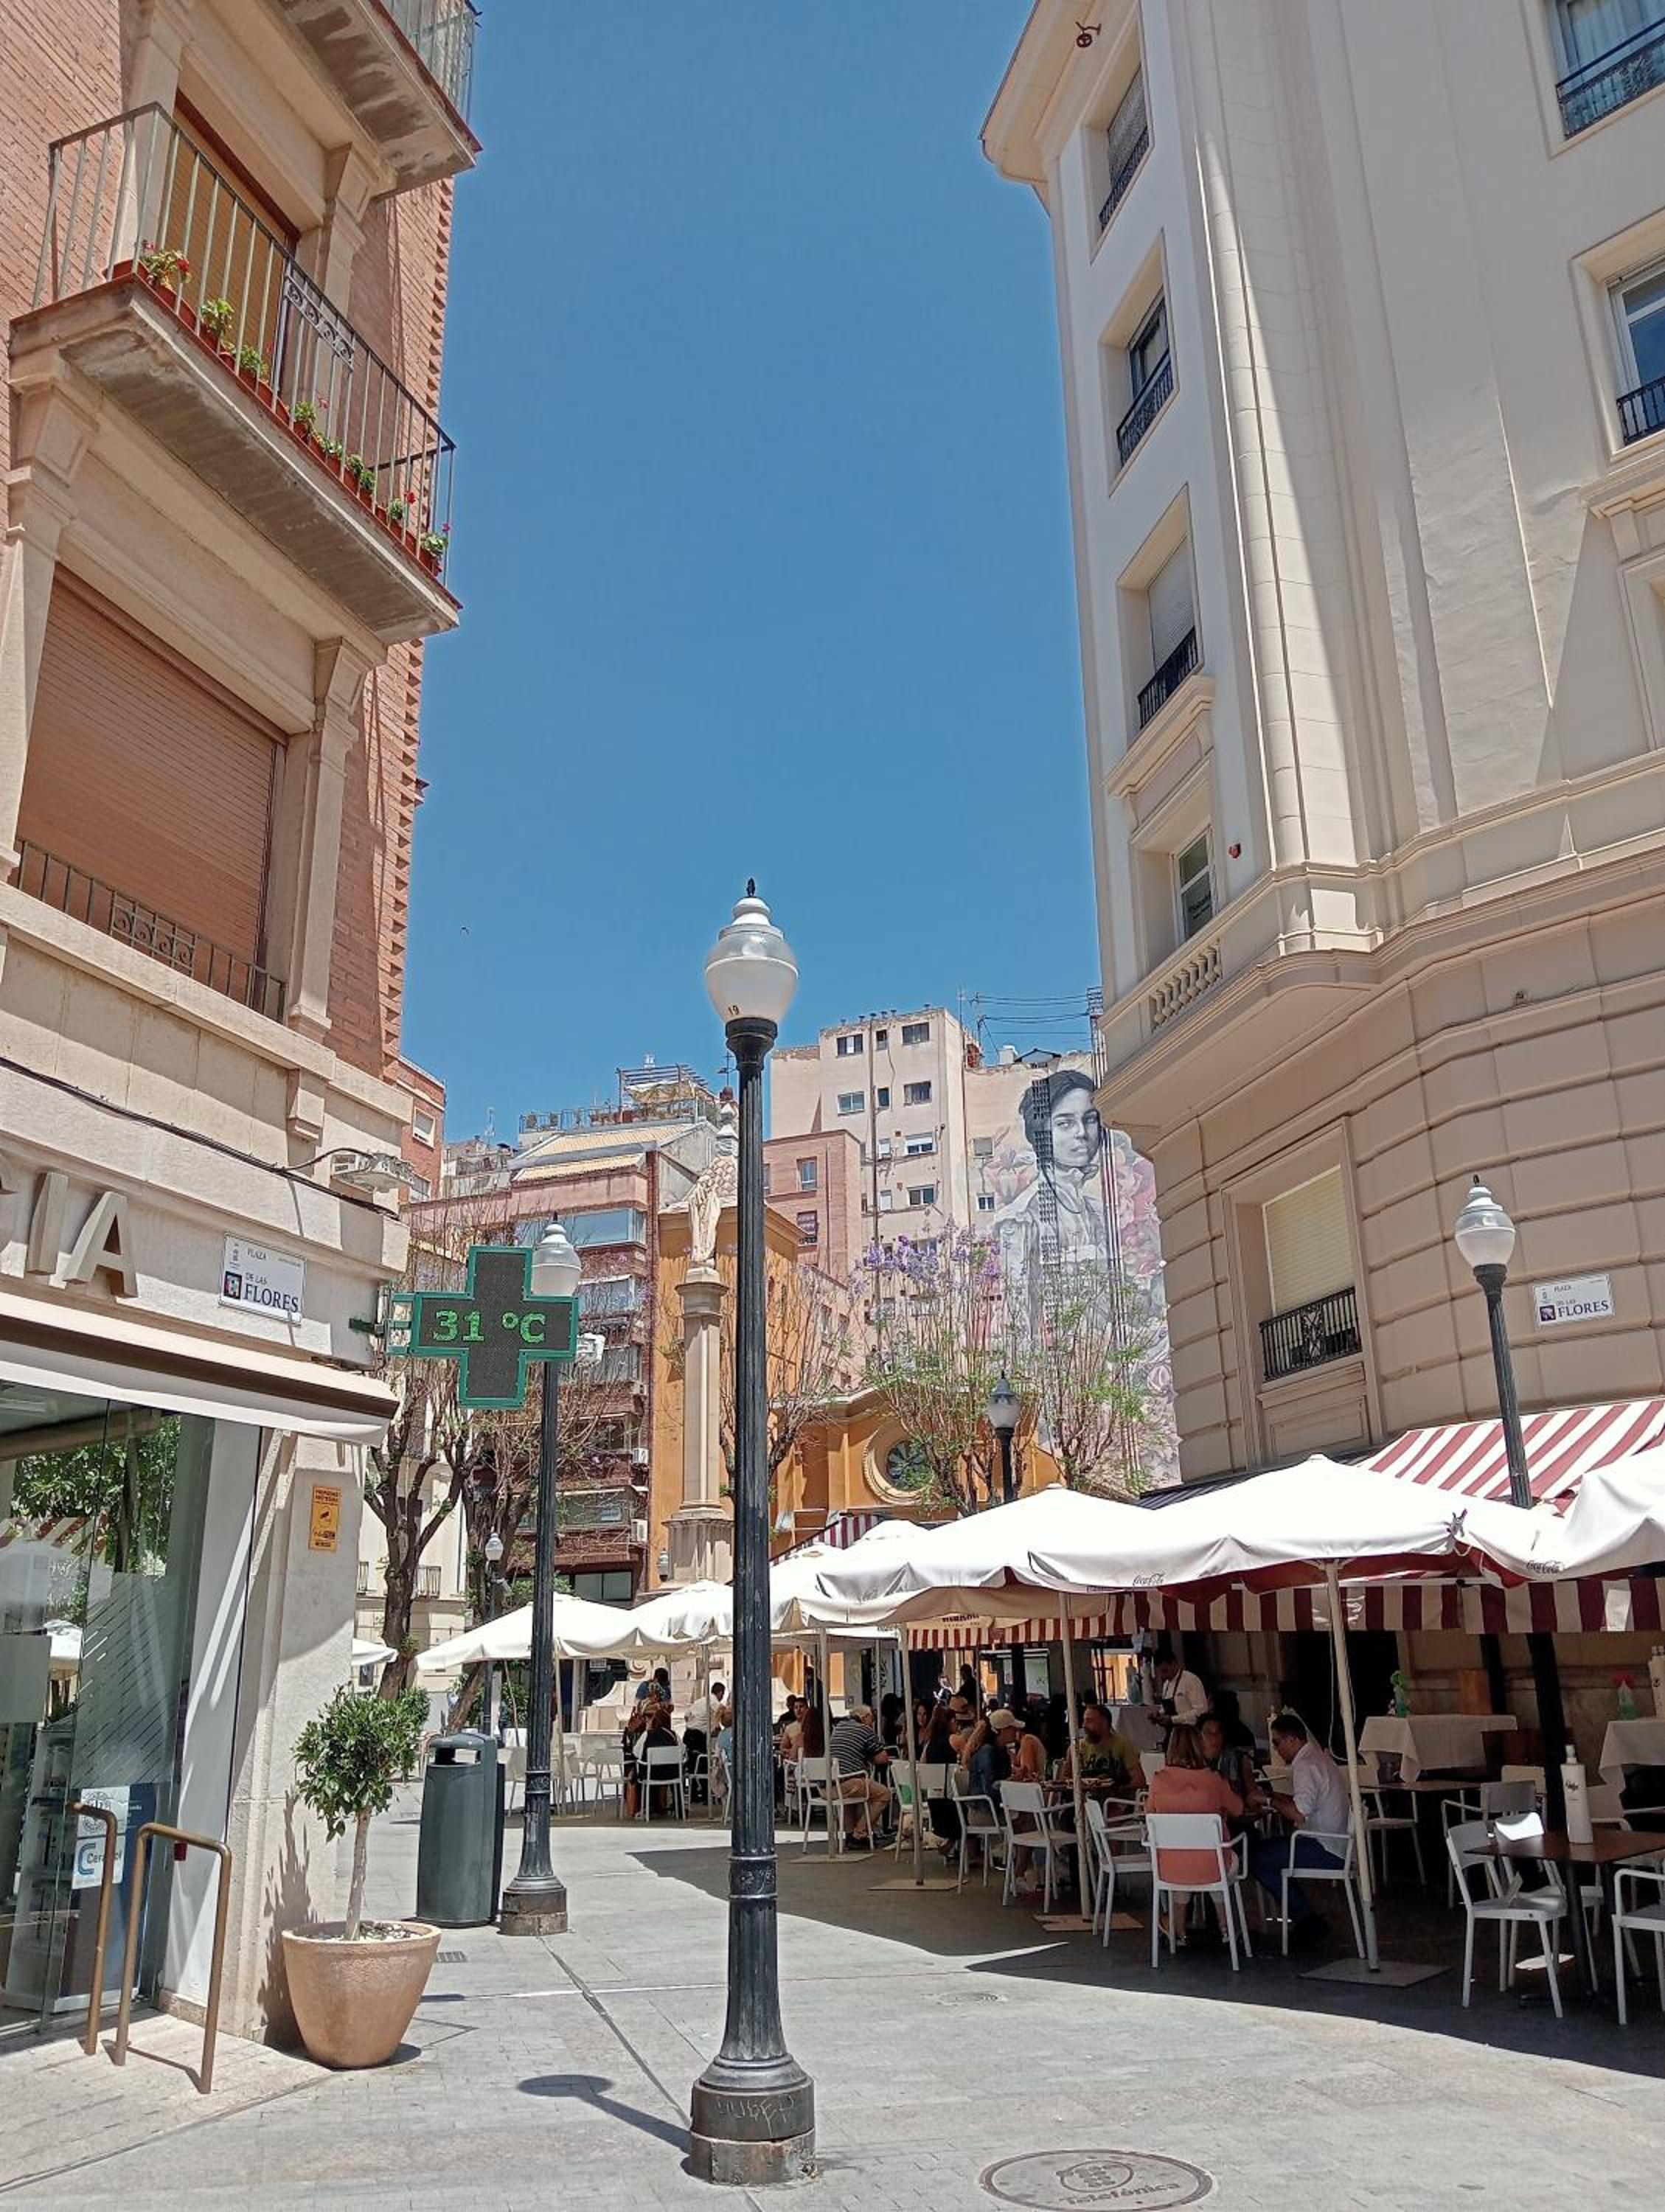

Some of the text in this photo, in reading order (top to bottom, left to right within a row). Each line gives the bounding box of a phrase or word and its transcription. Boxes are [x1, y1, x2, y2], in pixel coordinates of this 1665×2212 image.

[247, 1248, 266, 1260] PLAZA
[243, 1284, 299, 1312] FLORES
[1558, 1300, 1608, 1317] FLORES
[433, 1310, 546, 1343] 31 °C
